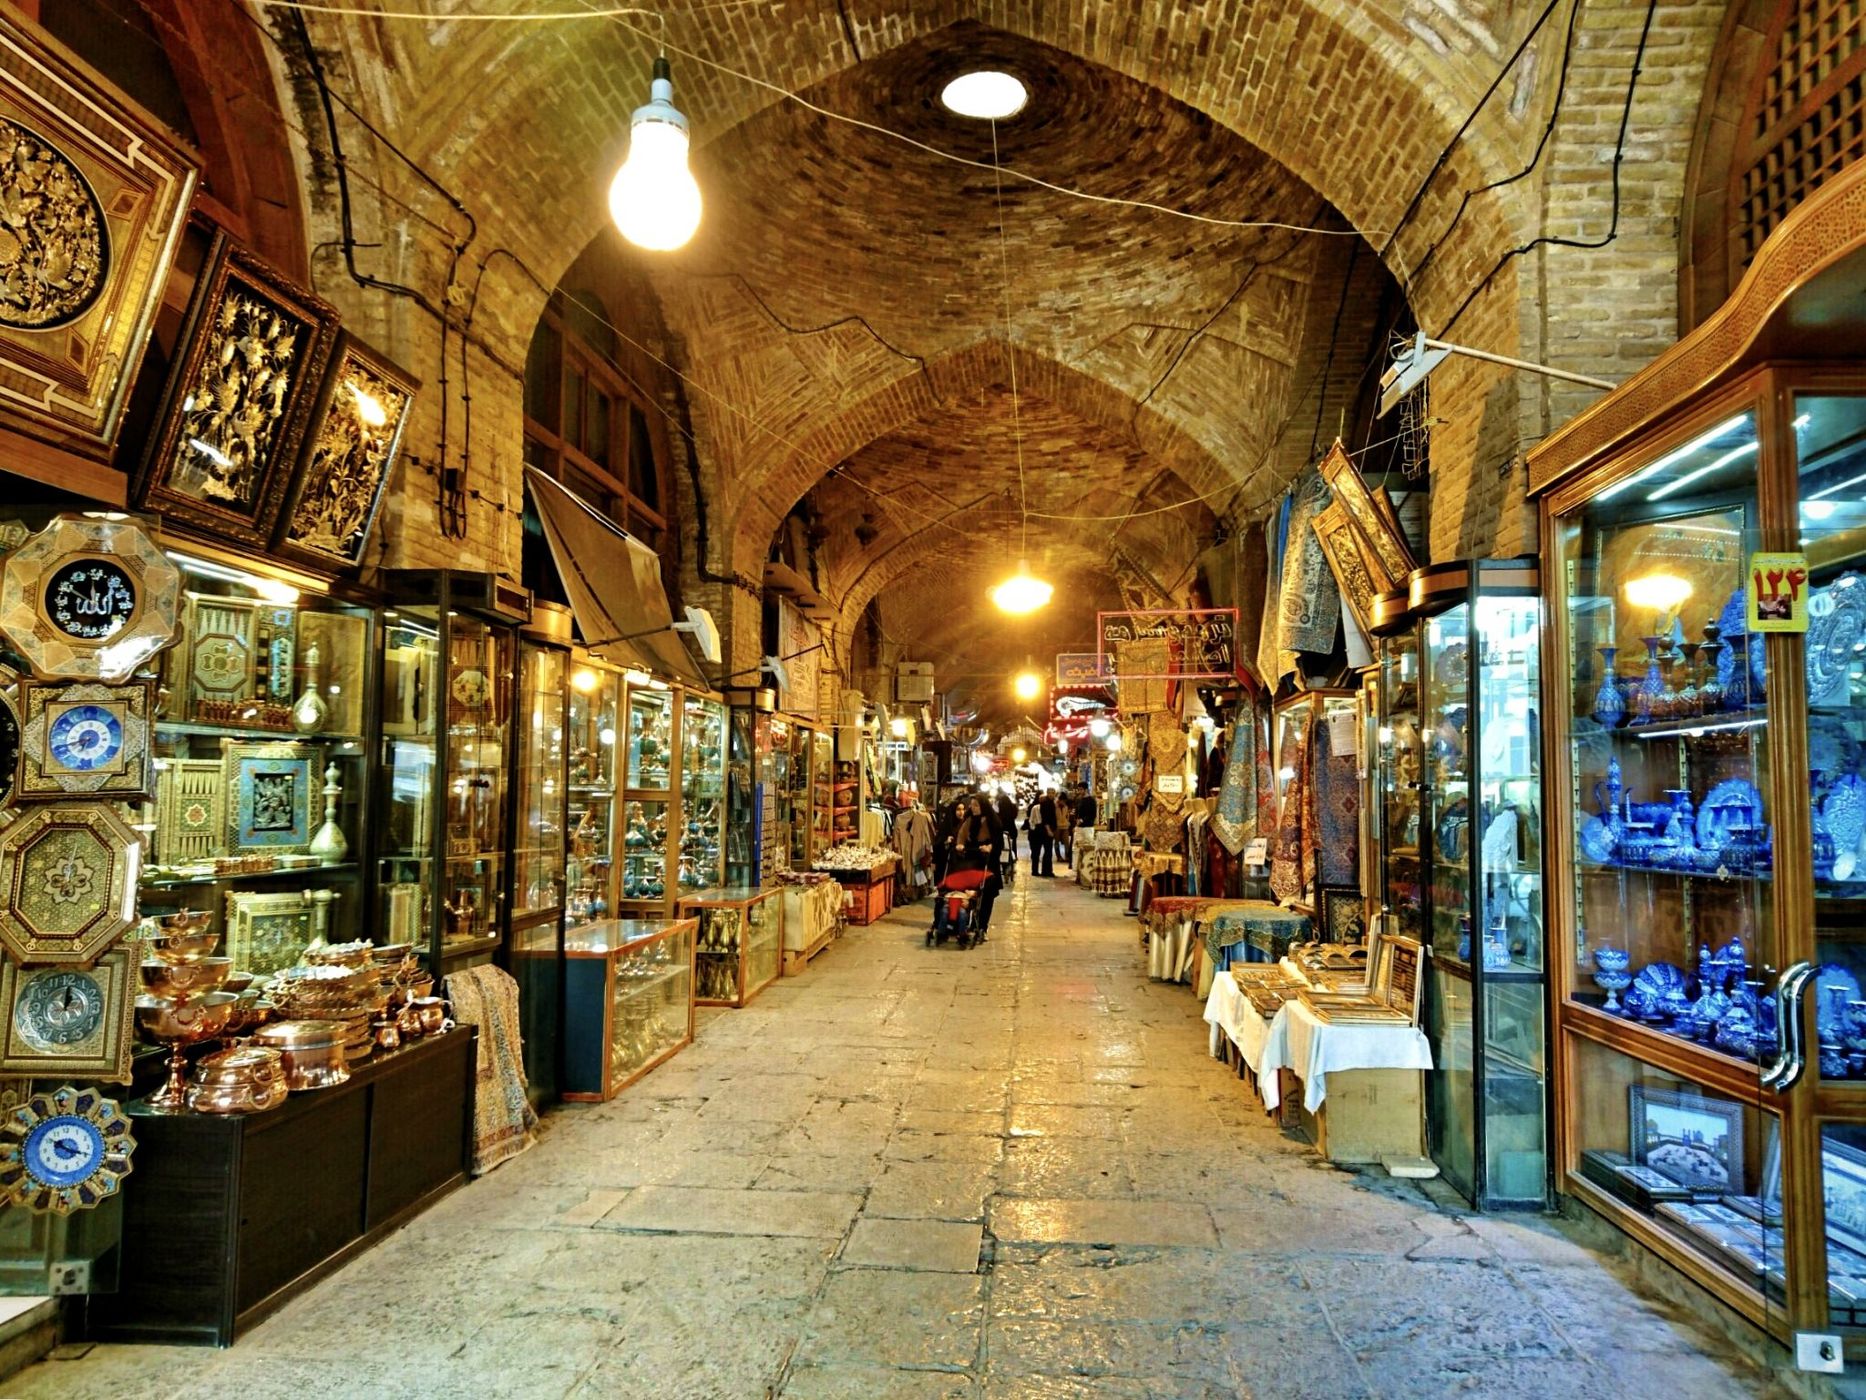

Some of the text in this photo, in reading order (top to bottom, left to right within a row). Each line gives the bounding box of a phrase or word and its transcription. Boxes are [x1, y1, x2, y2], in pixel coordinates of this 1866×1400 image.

[1753, 567, 1807, 602] ۱۲۴
[76, 586, 113, 615] الله
[7, 722, 14, 732] 2
[49, 978, 59, 987] 11
[62, 975, 76, 986] 12
[81, 979, 86, 989] 1
[37, 989, 49, 999] 10
[89, 988, 99, 999] 2
[32, 1002, 41, 1014] 9
[90, 1002, 101, 1014] 3
[34, 1016, 44, 1029] 8
[59, 1032, 68, 1044] 6
[75, 1027, 84, 1039] 5
